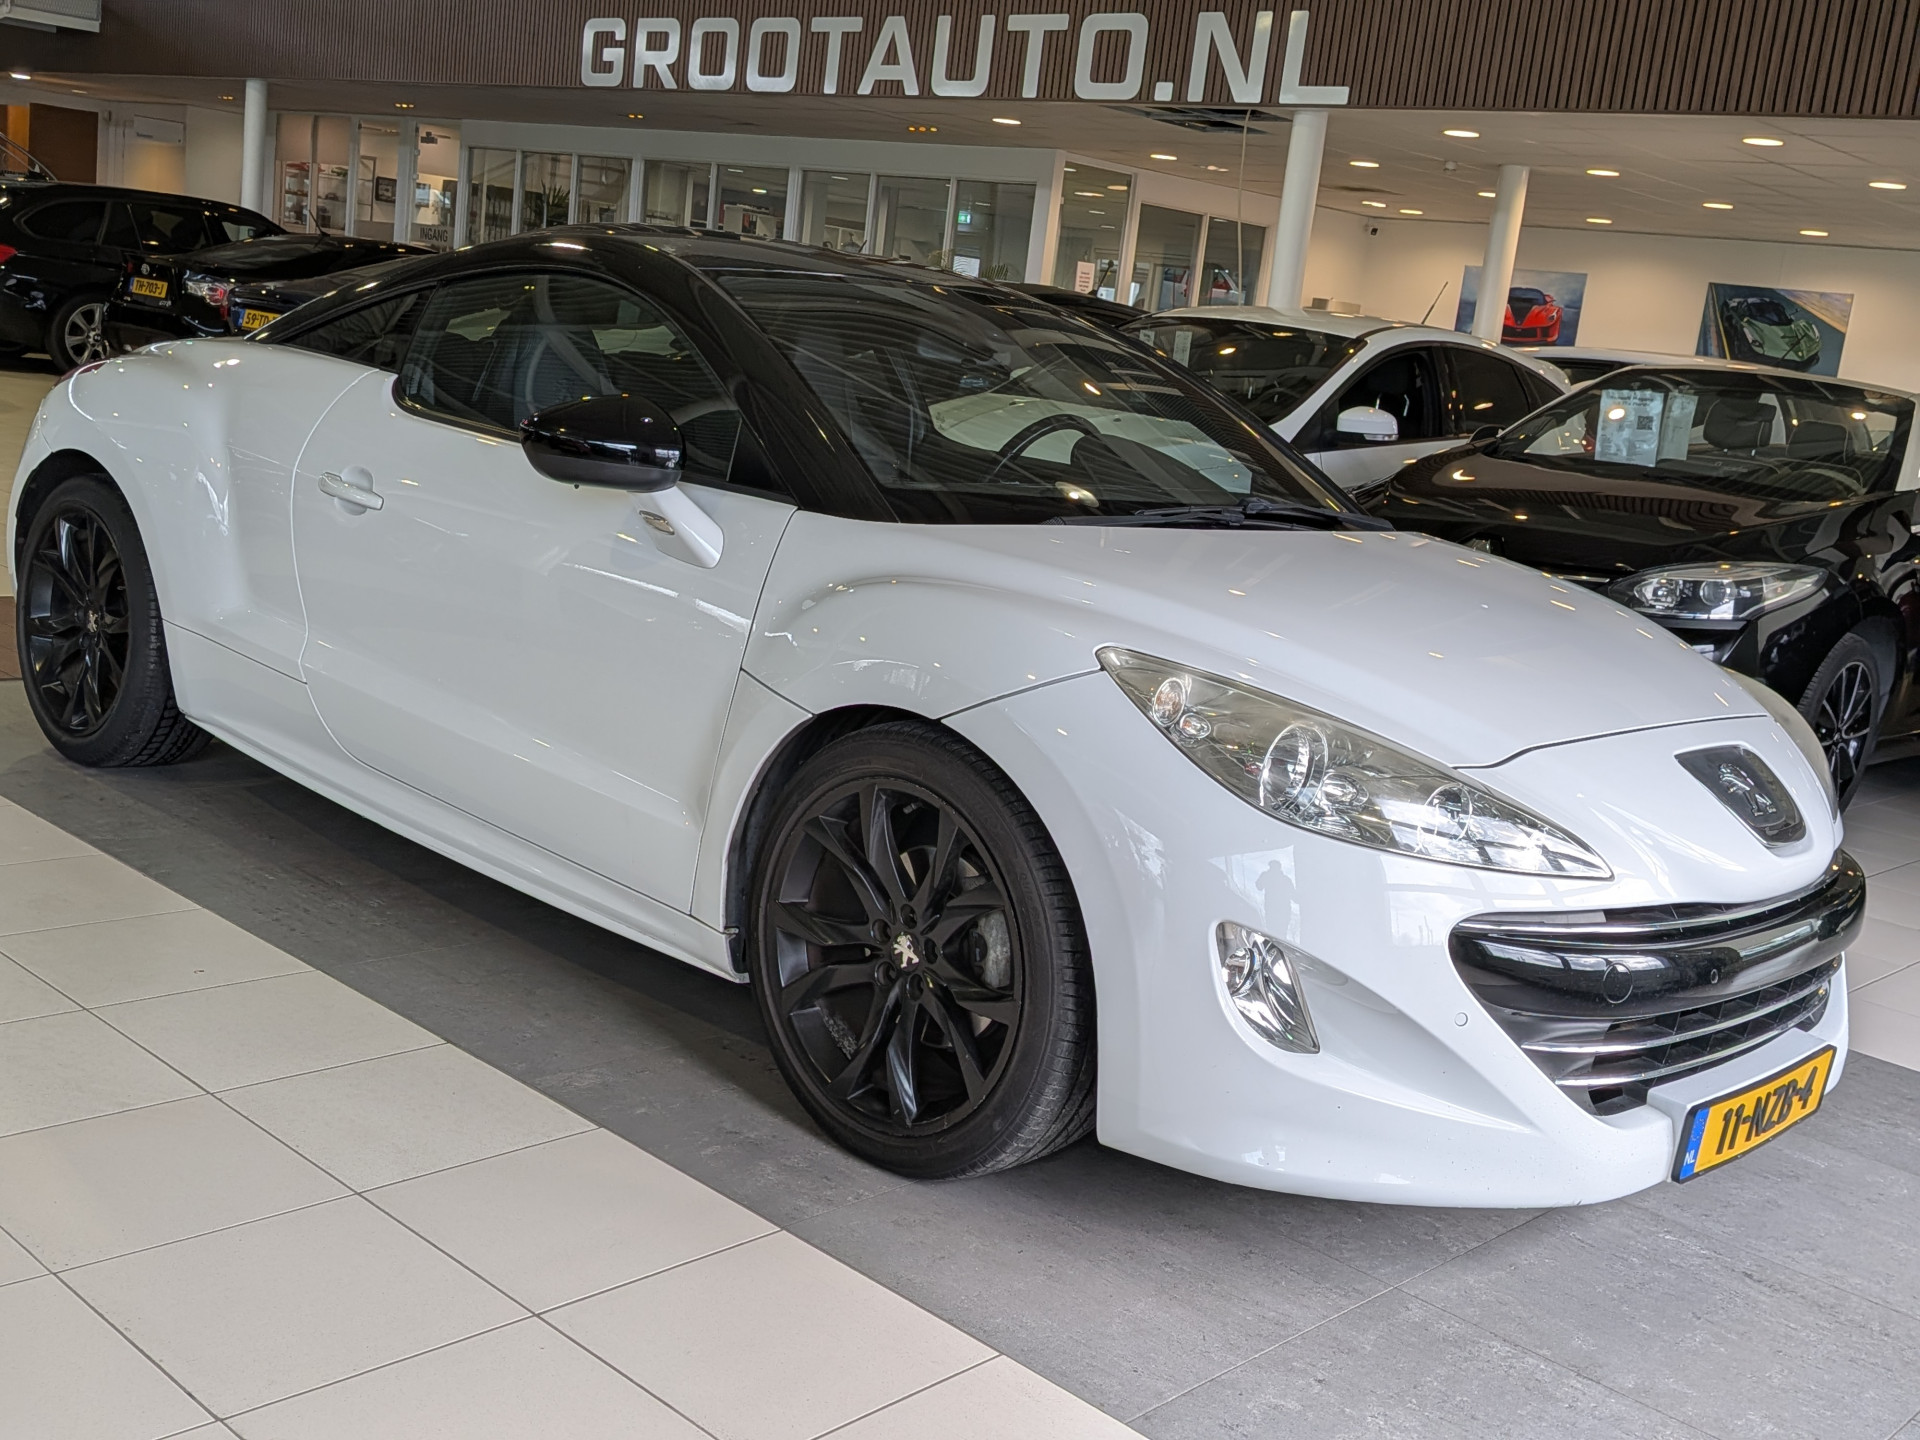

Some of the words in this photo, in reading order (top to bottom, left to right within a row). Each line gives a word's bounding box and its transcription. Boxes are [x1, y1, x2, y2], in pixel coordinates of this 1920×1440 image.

[581, 11, 1350, 105] GROOTAUTO.NL
[420, 227, 448, 242] INGANG
[134, 279, 165, 295] TH-703-J
[1715, 1066, 1818, 1155] 11-NZB-4
[1683, 1149, 1696, 1166] NL
